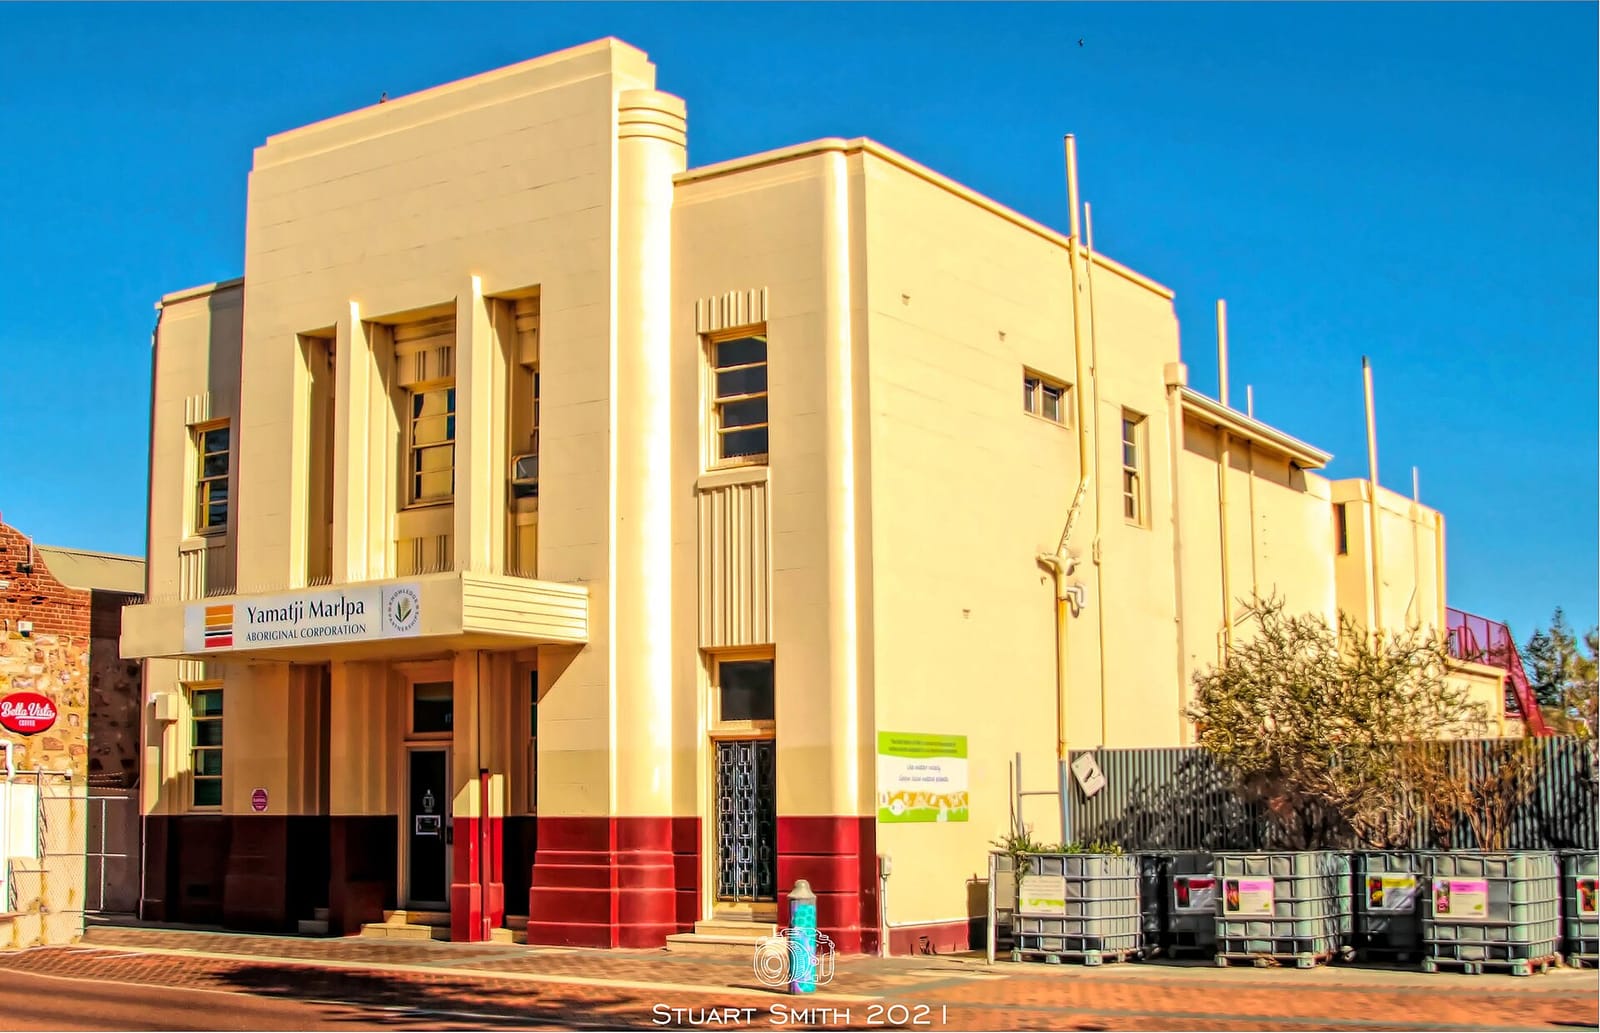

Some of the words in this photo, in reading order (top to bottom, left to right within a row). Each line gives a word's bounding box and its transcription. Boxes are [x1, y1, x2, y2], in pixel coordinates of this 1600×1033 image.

[247, 600, 304, 625] Yamatji
[308, 595, 365, 622] Marlpa
[246, 629, 298, 642] ABORIGINAL
[300, 623, 366, 639] CORPORATION
[1, 701, 27, 718] Bella
[28, 702, 55, 717] Vista
